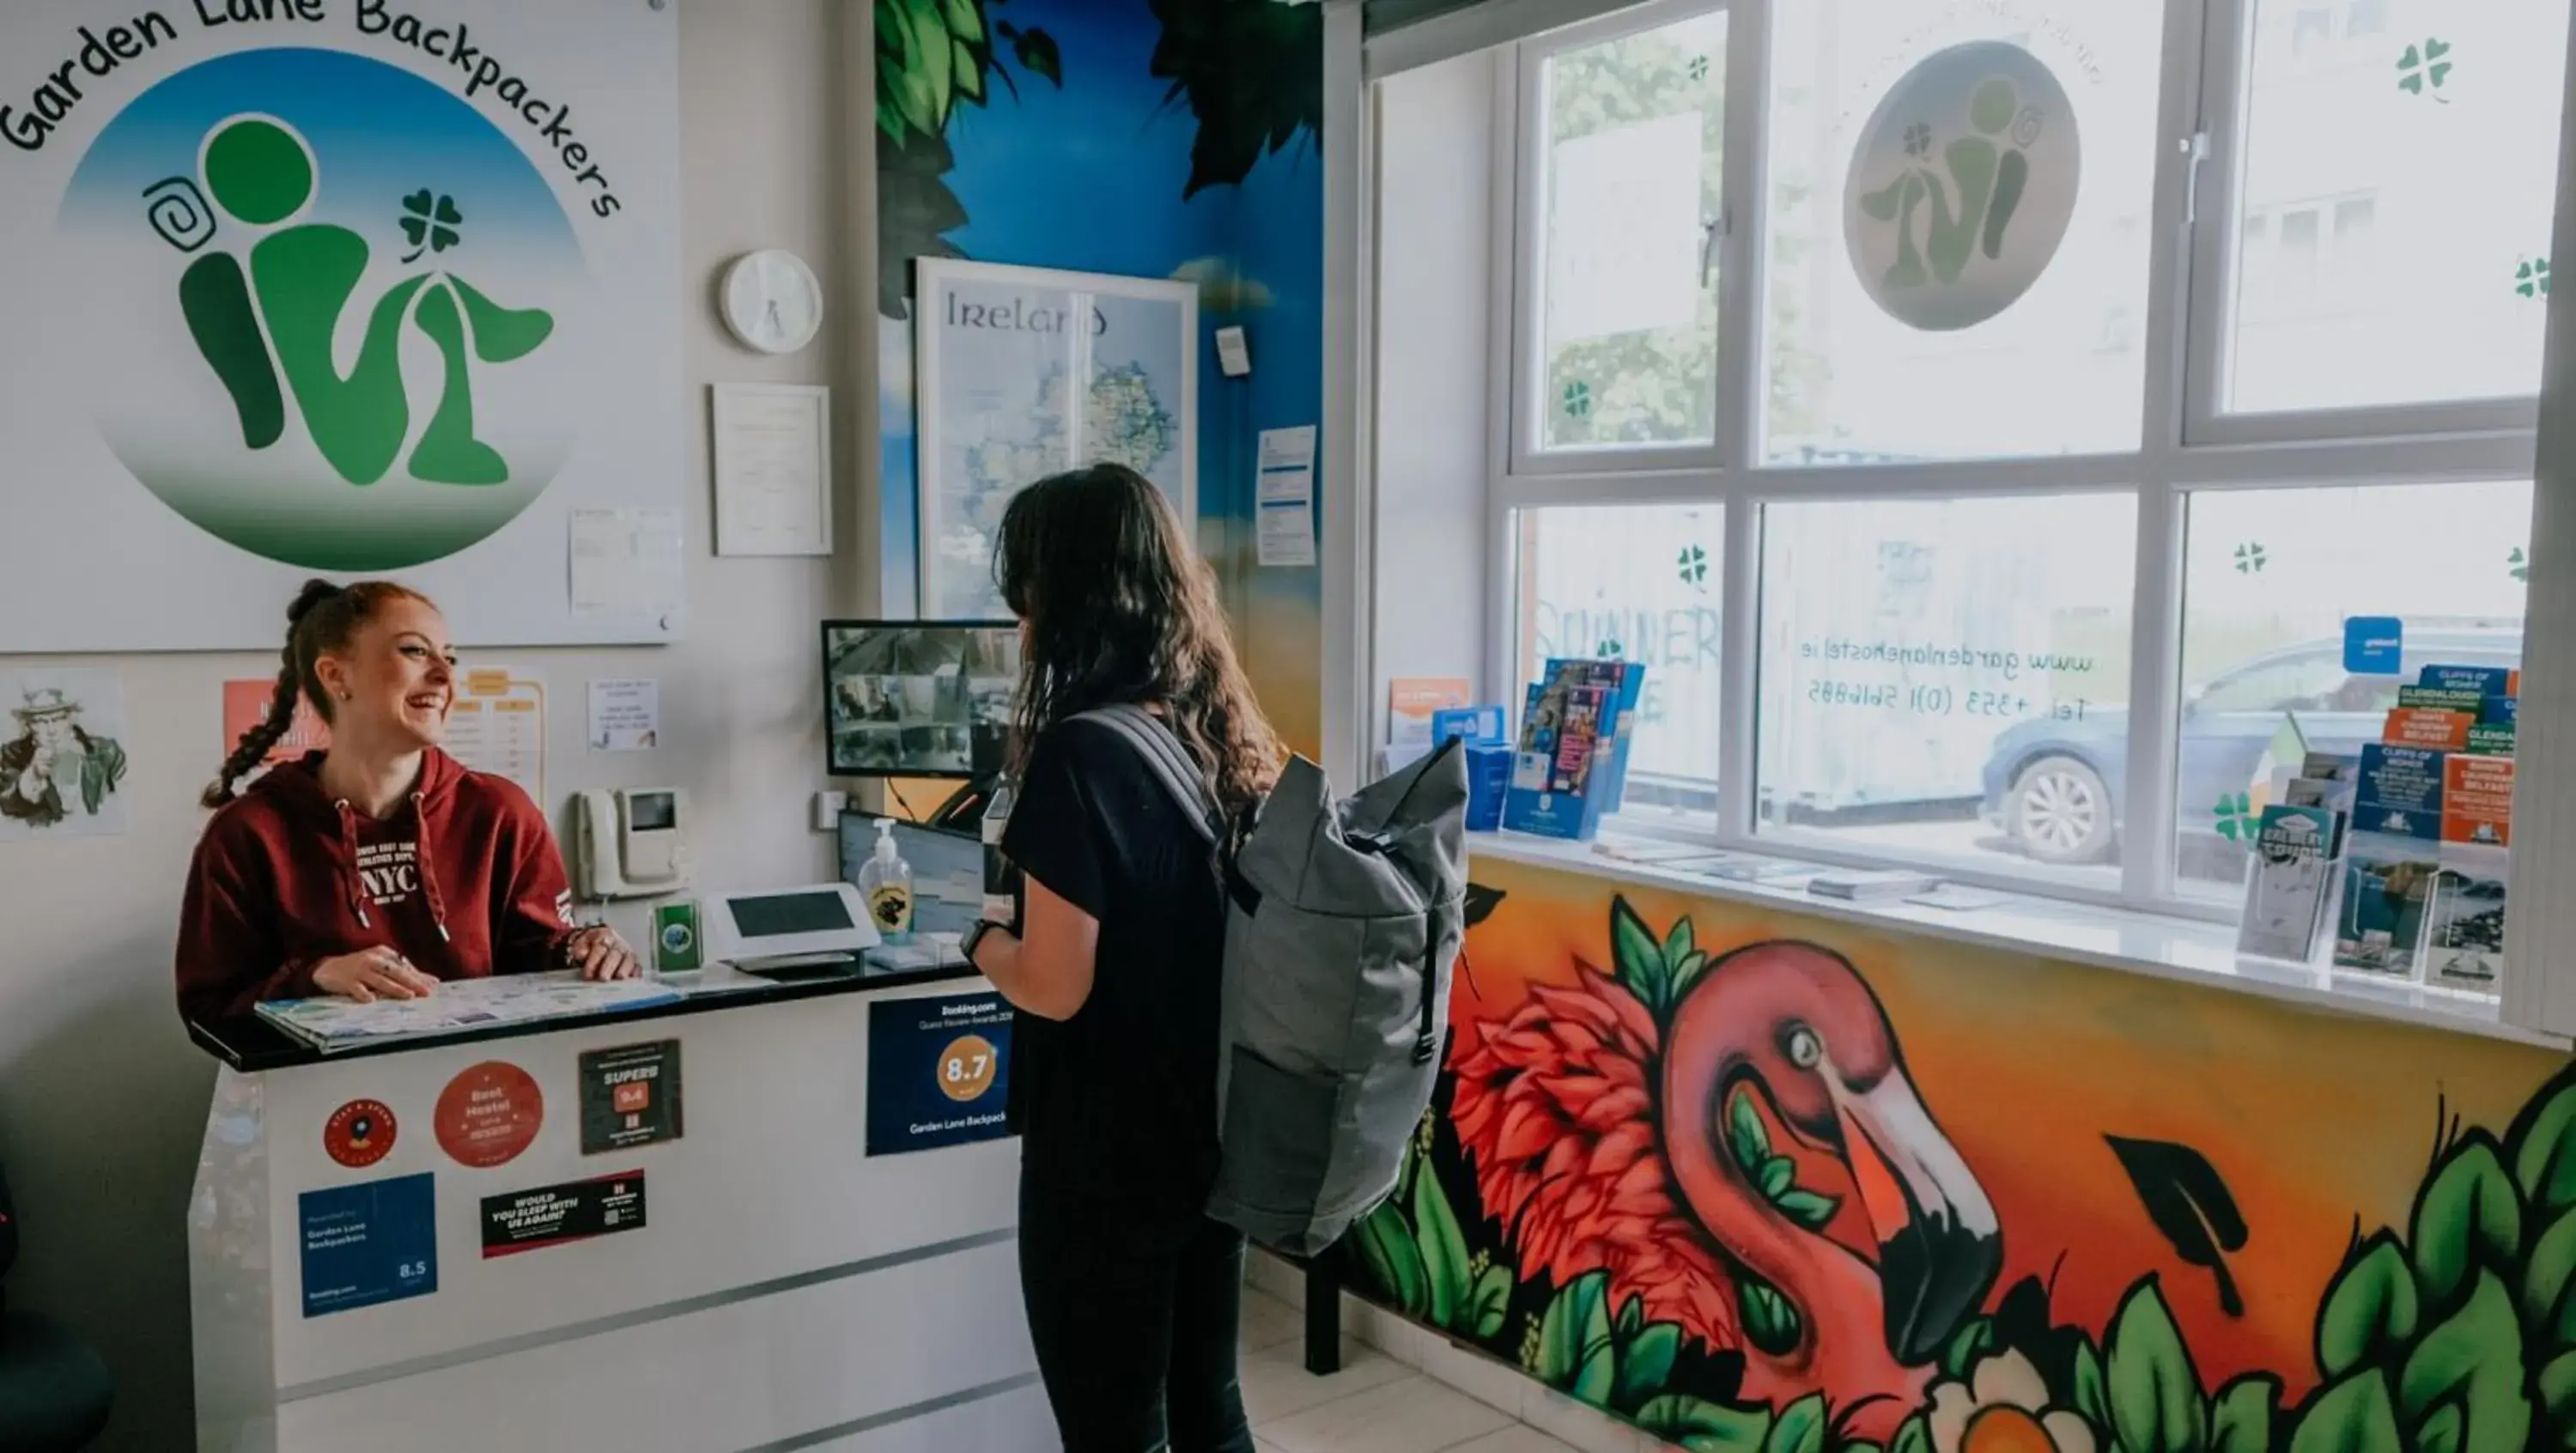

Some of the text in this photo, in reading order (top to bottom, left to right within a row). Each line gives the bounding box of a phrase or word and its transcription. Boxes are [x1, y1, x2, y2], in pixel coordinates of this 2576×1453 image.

[0, 0, 622, 218] Garden Lane Backpackers
[358, 865, 417, 897] NYC
[942, 1002, 997, 1016] Booking.com
[603, 1065, 659, 1085] SUPERB
[946, 1055, 987, 1081] 8.7
[471, 1085, 504, 1102] Best
[465, 1099, 511, 1116] Hostel
[910, 1122, 943, 1134] Garden
[944, 1117, 966, 1129] Lane
[514, 1193, 556, 1207] WOULD
[492, 1196, 579, 1223] YOU SLEEP WITH
[524, 1209, 567, 1226] AGAIN?
[307, 1222, 367, 1239] Garden Lane
[307, 1233, 368, 1250] Backpackers
[399, 1261, 427, 1278] 8.5
